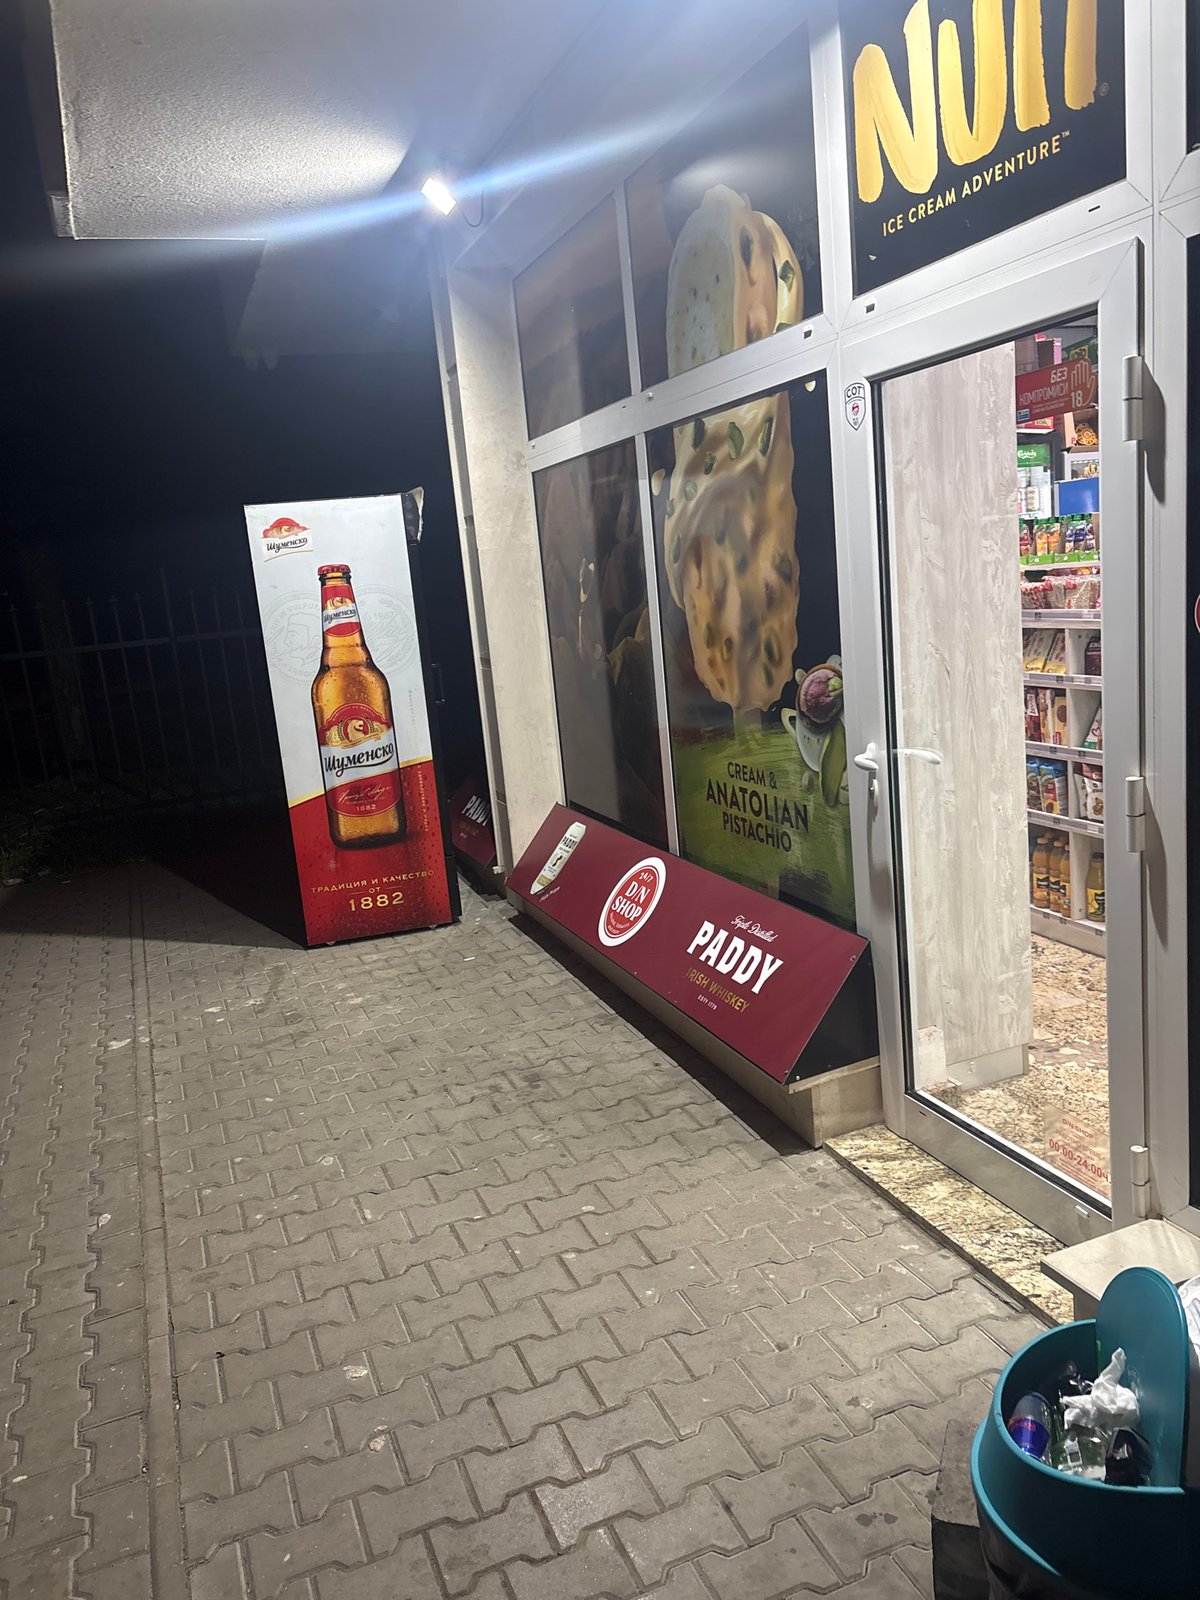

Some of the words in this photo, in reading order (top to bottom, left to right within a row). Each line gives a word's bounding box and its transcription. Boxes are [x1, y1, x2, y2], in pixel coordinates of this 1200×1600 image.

[883, 215, 904, 237] ICE
[908, 190, 957, 225] CREAM
[1050, 367, 1068, 383] БЕЗ
[1071, 390, 1083, 409] 18
[266, 537, 308, 553] Шуменско
[323, 609, 357, 624] Шуменско
[324, 743, 395, 778] Шуменско
[727, 762, 766, 787] CREAM
[769, 771, 777, 789] &
[355, 804, 377, 812] 1882
[706, 778, 809, 834] ANATOLIAN
[560, 836, 578, 850] PADDY
[722, 811, 792, 852] PISTACHIO
[310, 879, 368, 894] ТРАДИЦИЯ
[382, 870, 435, 883] КАЧЕСТВО
[638, 872, 654, 883] 24/7
[349, 891, 405, 912] 1882
[368, 886, 381, 894] ОТ
[625, 880, 651, 904] D/N
[611, 895, 643, 921] SHOP
[731, 914, 753, 930] Triple
[747, 923, 779, 943] Distilled
[686, 920, 784, 995] PADDY
[685, 968, 711, 989] IRISH
[708, 981, 750, 1013] WHISKEY
